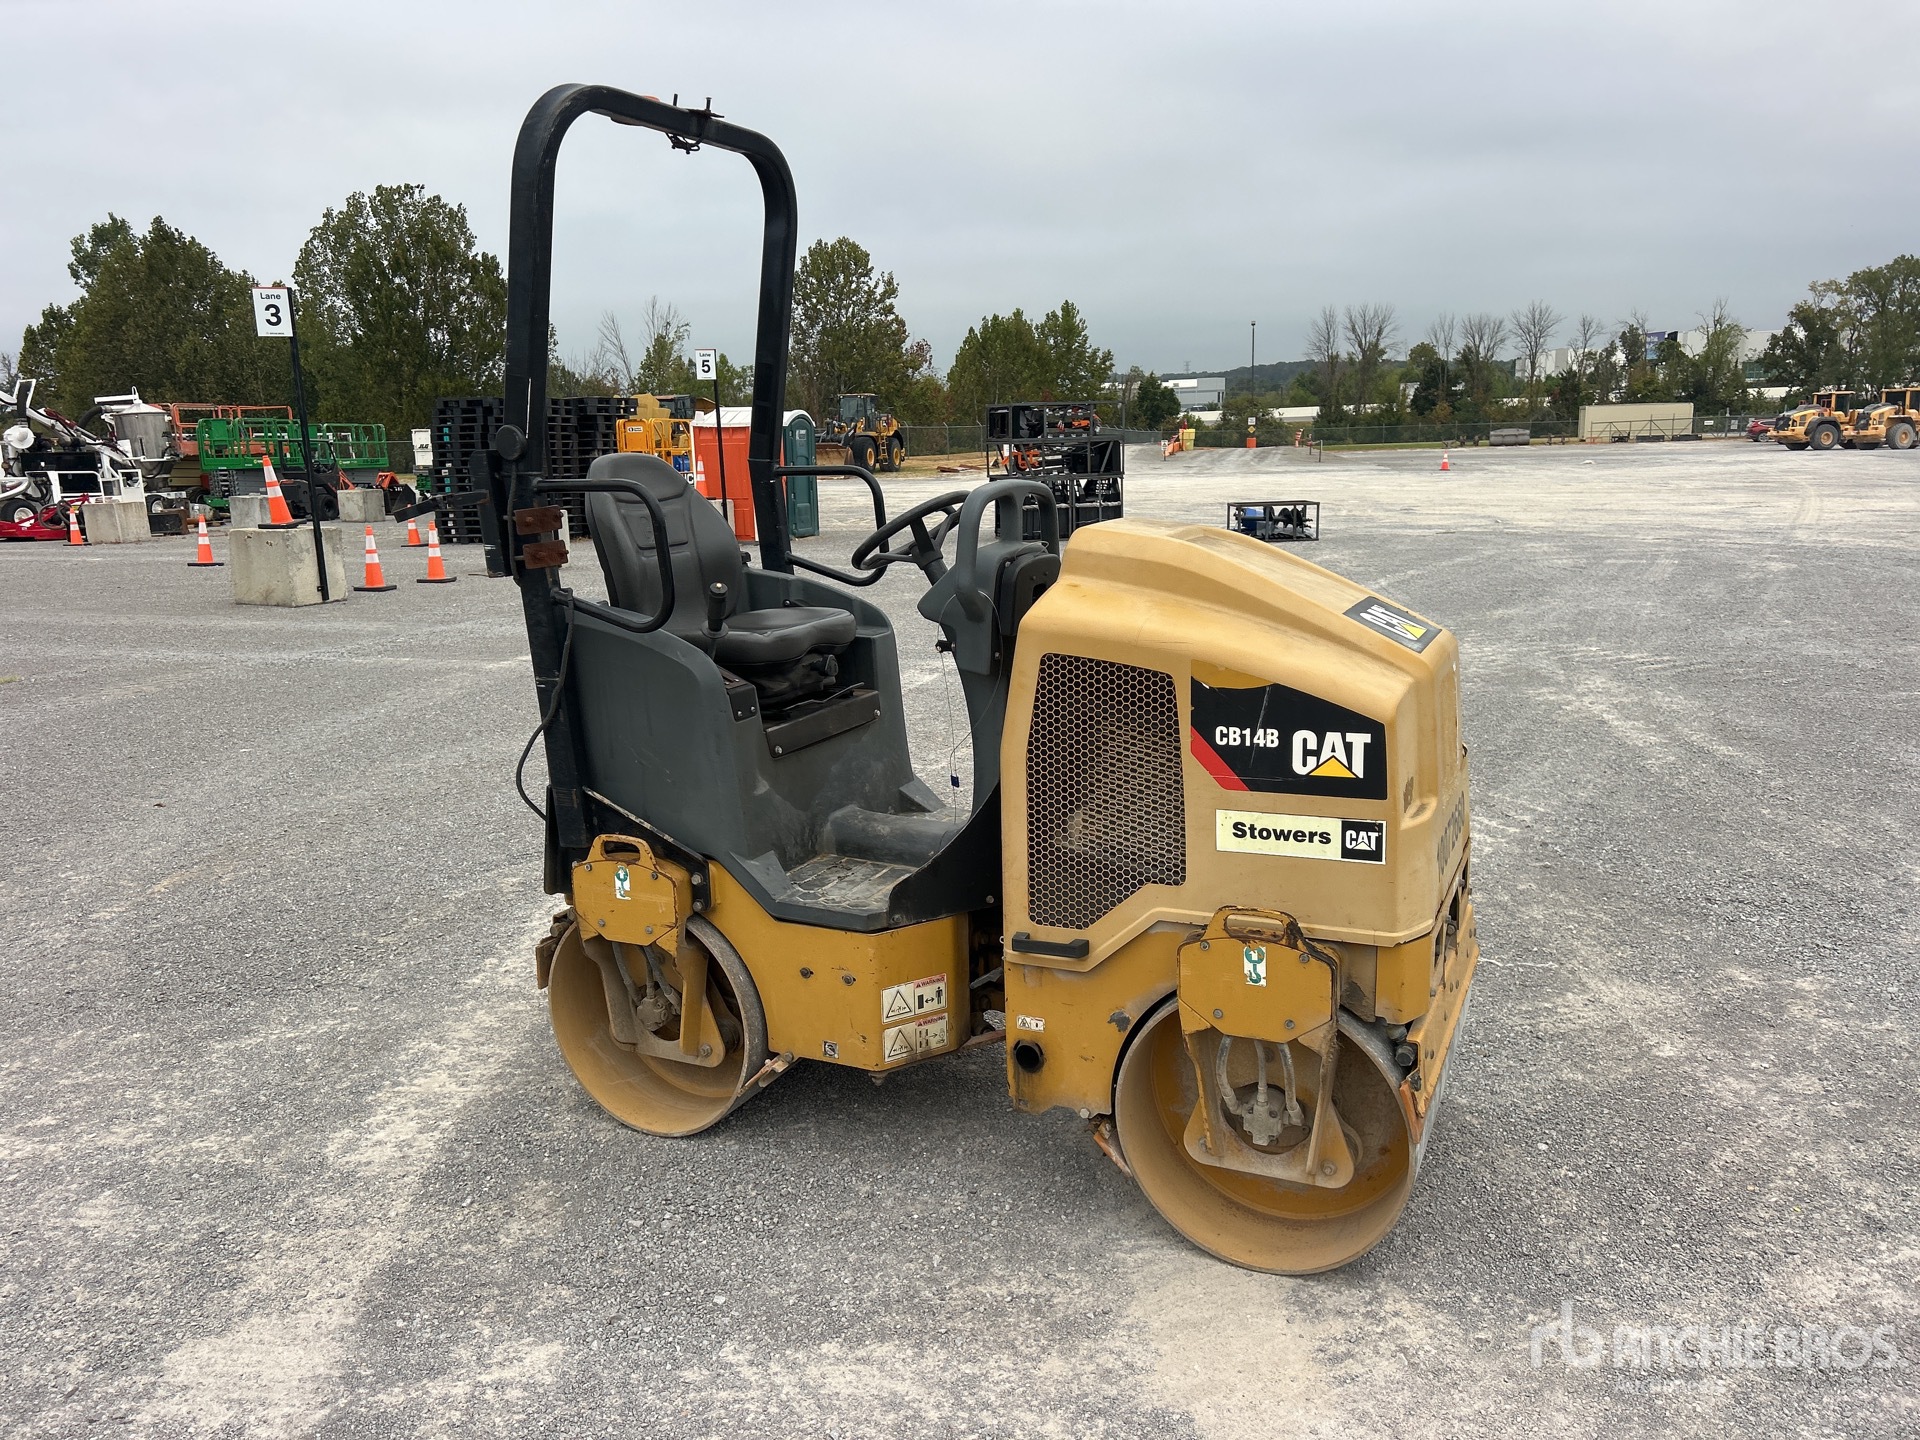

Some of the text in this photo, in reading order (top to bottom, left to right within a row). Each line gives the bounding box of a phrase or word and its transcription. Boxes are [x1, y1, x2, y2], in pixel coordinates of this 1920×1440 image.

[260, 292, 281, 300] Lane
[264, 303, 282, 327] 3
[701, 359, 711, 374] 5
[1215, 725, 1372, 779] CB14B CAT
[1232, 821, 1379, 851] Stowers CAT
